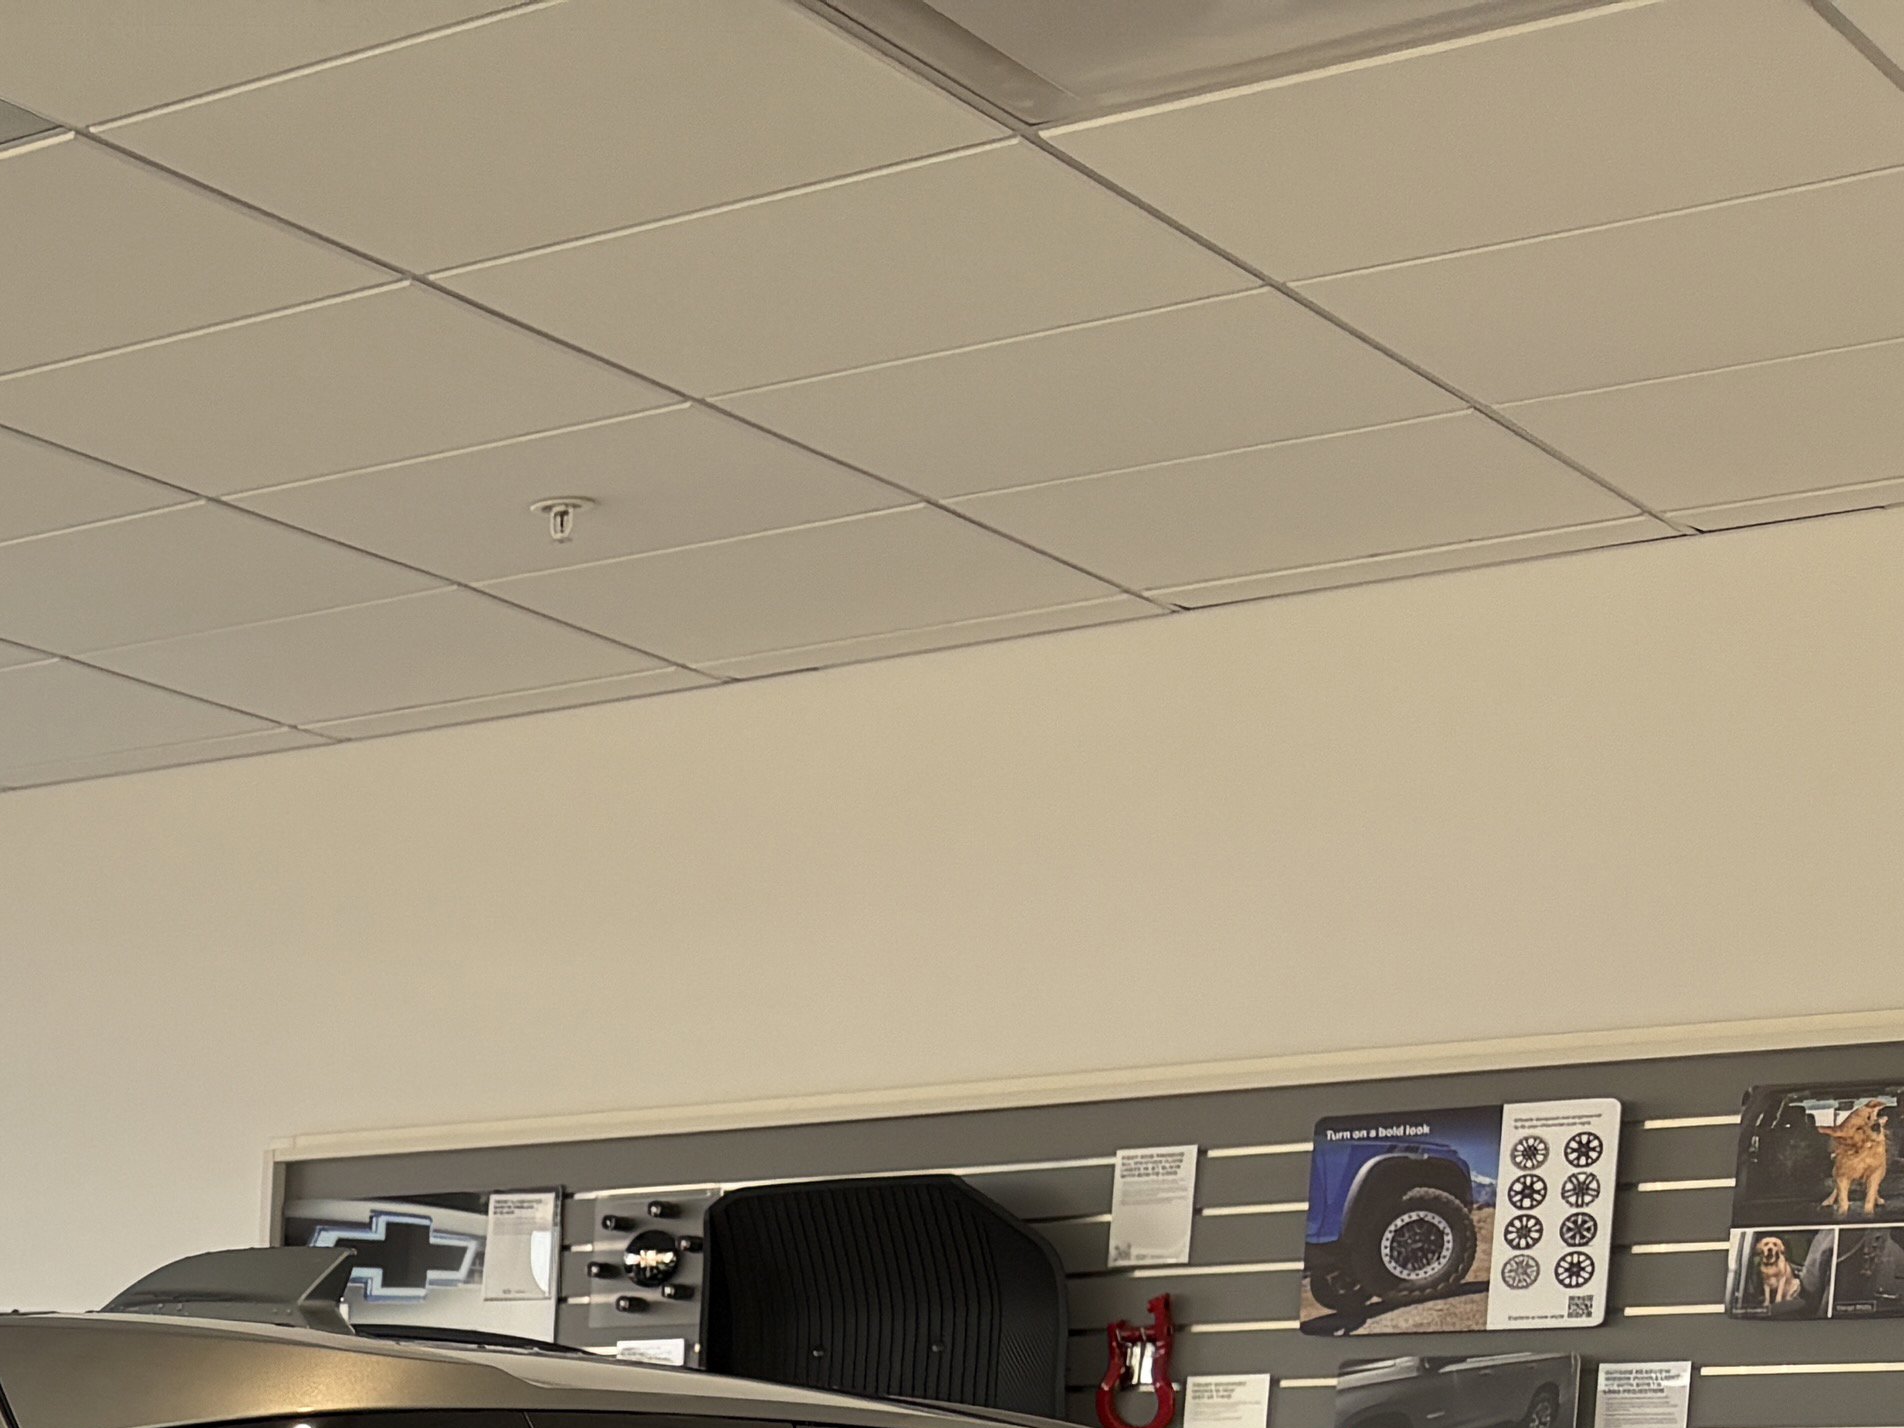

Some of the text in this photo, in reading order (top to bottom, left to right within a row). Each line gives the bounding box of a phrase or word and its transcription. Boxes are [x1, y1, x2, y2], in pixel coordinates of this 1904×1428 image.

[1325, 1123, 1431, 1140] Turn on a bold look
